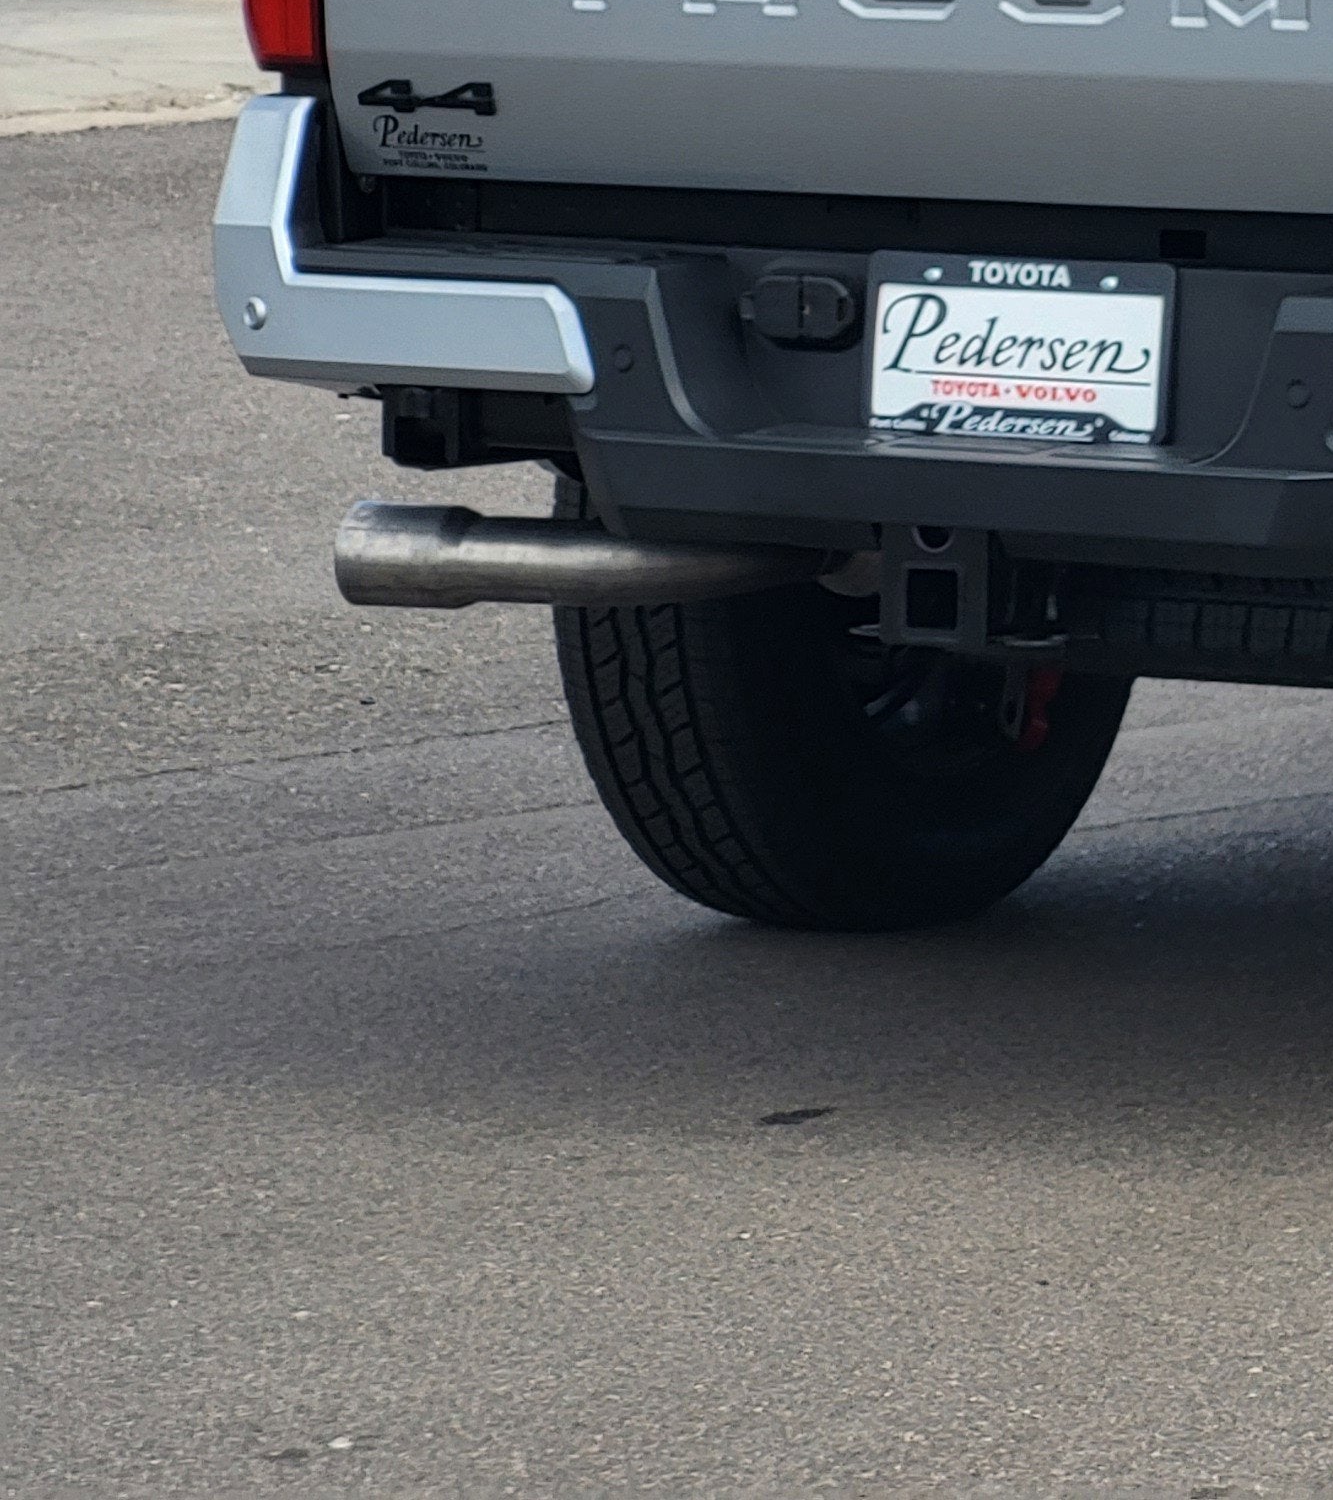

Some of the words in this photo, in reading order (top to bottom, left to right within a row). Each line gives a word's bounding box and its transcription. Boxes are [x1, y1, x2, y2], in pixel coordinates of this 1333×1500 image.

[373, 114, 483, 148] Pedersen
[968, 261, 1072, 288] TOYOTA
[882, 293, 1152, 374] Pedersen
[931, 379, 1000, 398] TOYOTA
[1015, 384, 1098, 403] VOLVO
